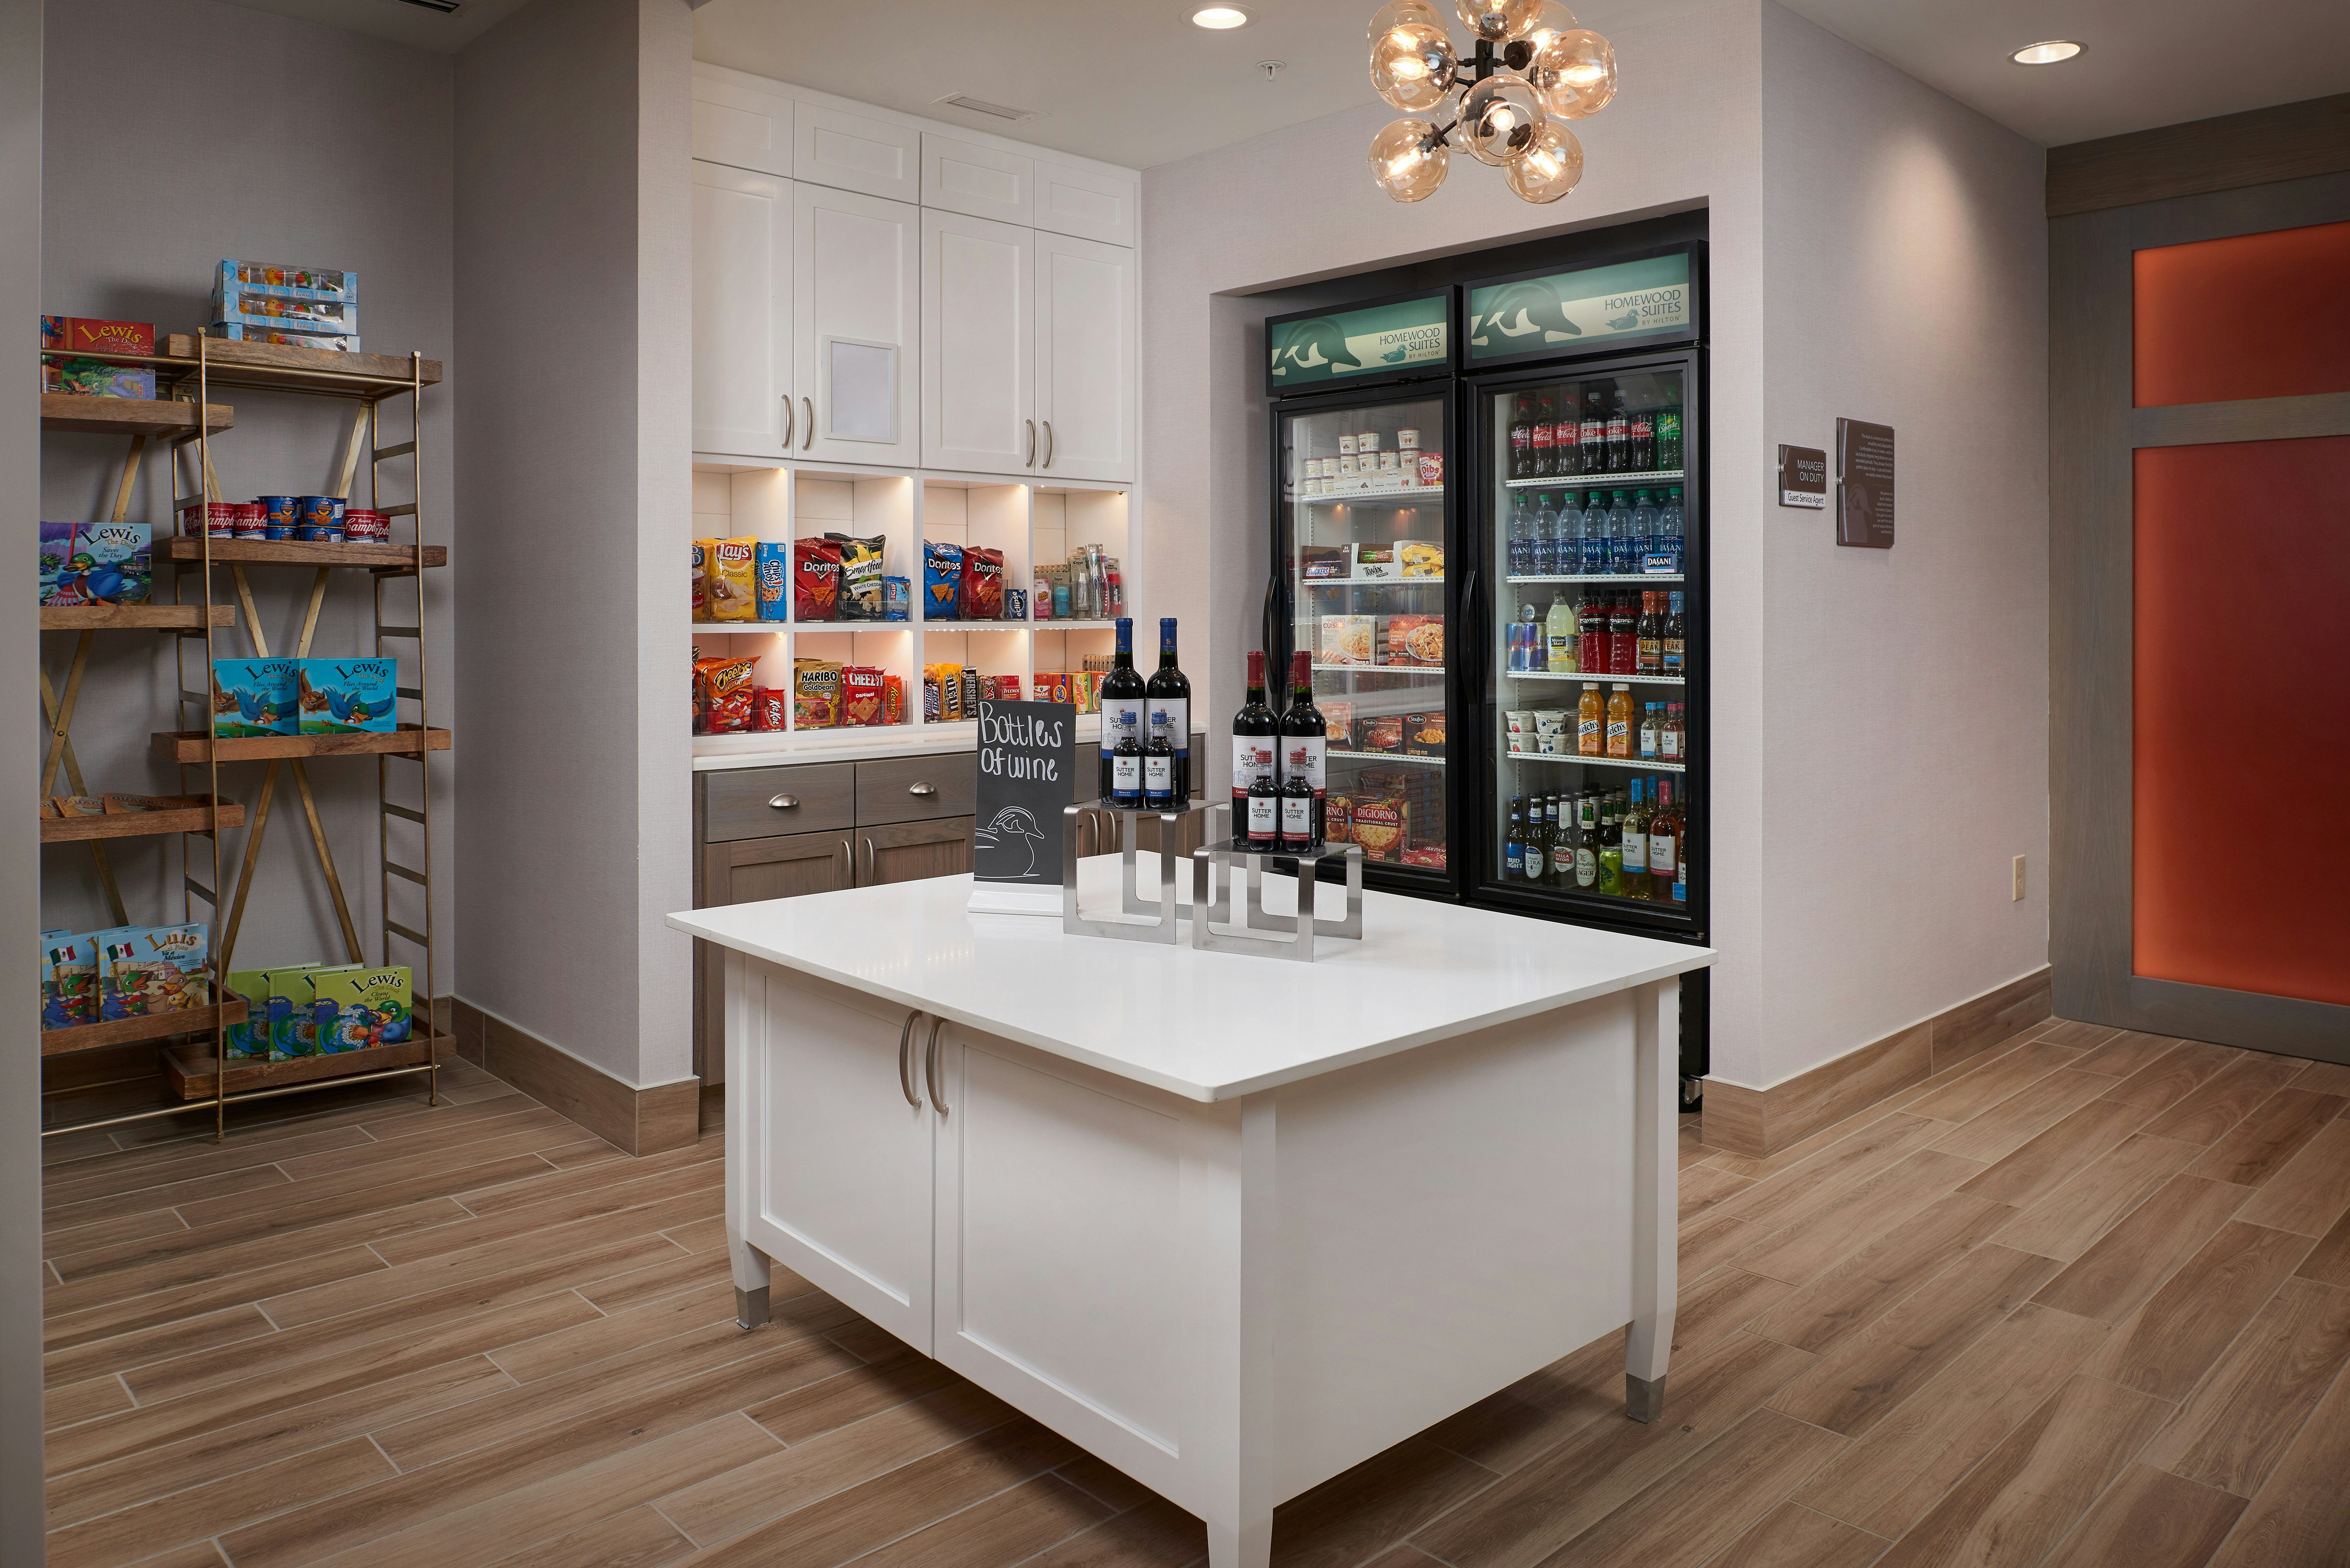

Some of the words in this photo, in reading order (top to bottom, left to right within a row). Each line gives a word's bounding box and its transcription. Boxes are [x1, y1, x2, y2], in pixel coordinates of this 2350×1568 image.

[1605, 290, 1681, 310] HOMEWOOD
[1642, 302, 1681, 317] SUITES
[78, 325, 143, 343] Lewis
[1380, 328, 1440, 345] HOMEWOOD
[121, 338, 137, 349] Duck
[1409, 338, 1440, 351] SUITES
[1580, 429, 1596, 437] Coke
[1660, 421, 1678, 433] Sprite
[1422, 464, 1439, 474] Dibs
[1797, 459, 1824, 471] MANAGER
[1800, 472, 1808, 481] ON
[1810, 473, 1824, 483] DUTY
[1788, 493, 1799, 502] Guest
[1799, 494, 1812, 503] Service
[1813, 496, 1824, 505] Agent
[78, 526, 141, 546] Lewis
[120, 539, 136, 551] Duck
[720, 545, 749, 561] Lay's
[804, 562, 840, 572] Doritos
[845, 560, 882, 578] Smartfood
[928, 558, 961, 570] Doritos
[975, 562, 1003, 574] Doritos
[1648, 557, 1671, 566] DASANI
[770, 560, 782, 583] Chips
[1012, 591, 1022, 617] eclipse
[244, 661, 297, 681] Lewis
[334, 661, 388, 681] Lewis
[370, 673, 385, 684] Duck
[716, 662, 752, 690] Cheetos
[801, 672, 837, 682] HARIBO
[890, 686, 899, 716] Reese's
[967, 674, 977, 715] HERSHEY'S
[979, 701, 1063, 747] Bottles
[1578, 721, 1599, 734] Welch's
[1008, 751, 1058, 781] wine
[144, 928, 197, 951] Luis
[350, 971, 404, 994] Lewis
[387, 984, 400, 994] Duck
